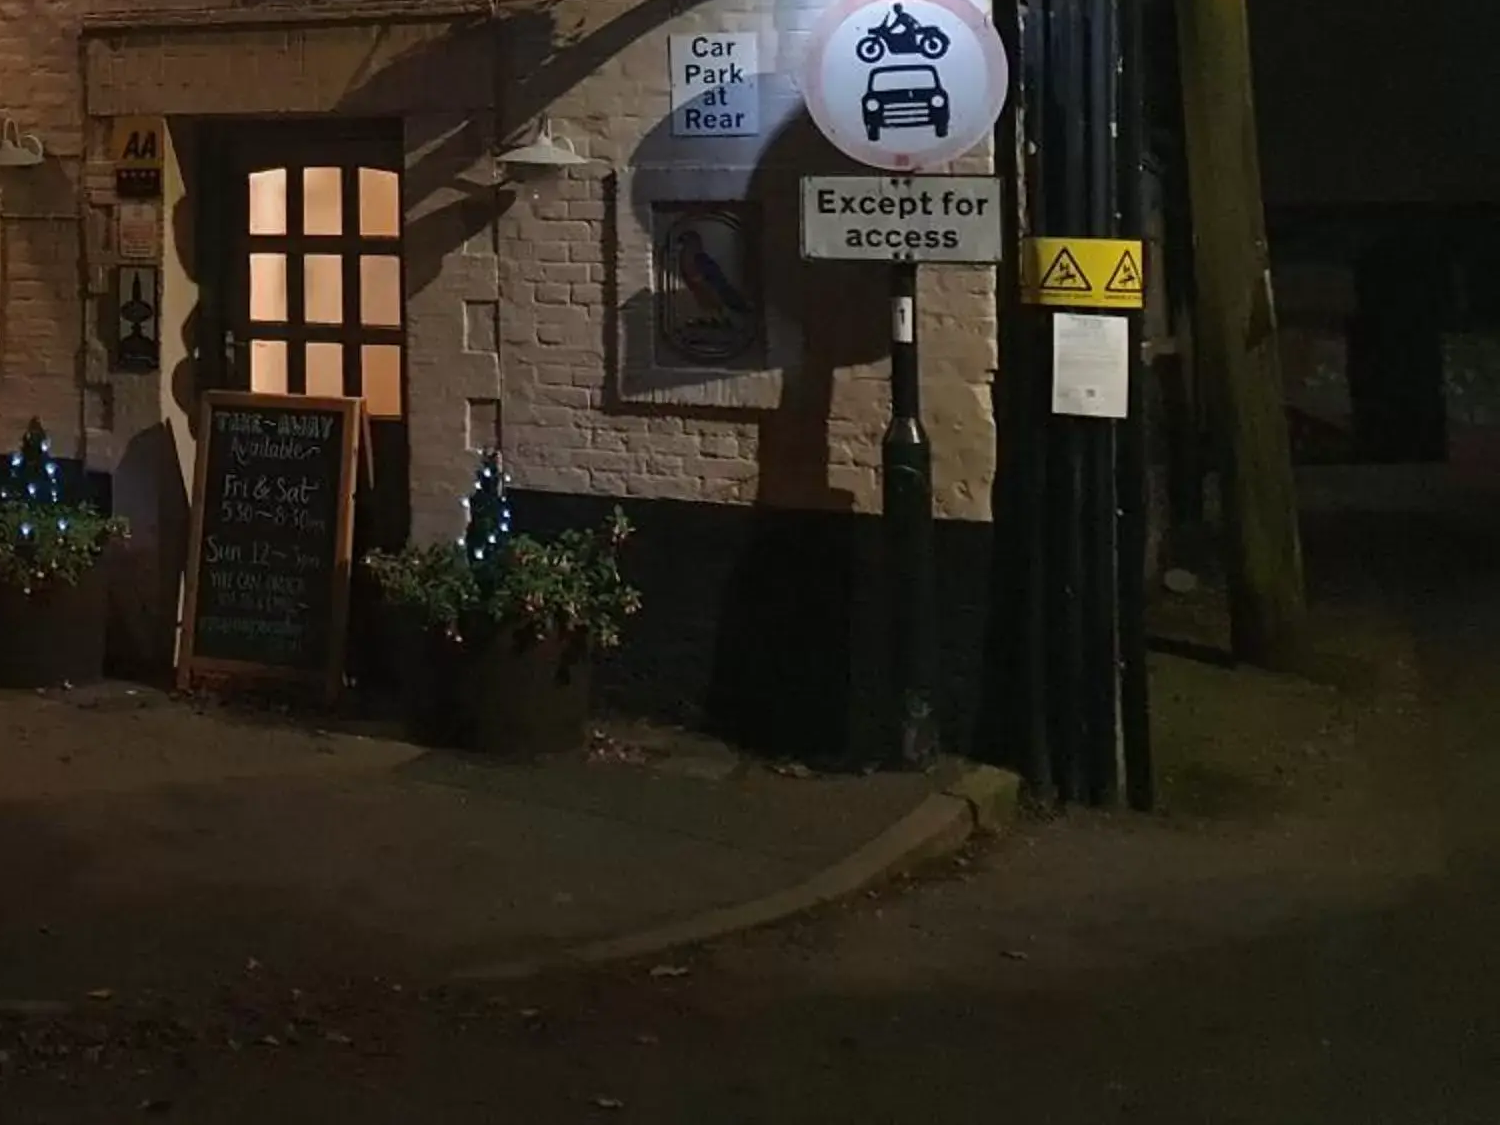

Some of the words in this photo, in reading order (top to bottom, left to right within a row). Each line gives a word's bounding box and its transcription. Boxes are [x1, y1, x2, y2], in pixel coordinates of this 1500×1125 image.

[691, 36, 735, 58] Car
[685, 62, 744, 85] Park
[703, 86, 727, 107] at
[685, 108, 746, 130] Rear
[122, 130, 156, 159] AA
[817, 189, 933, 220] Except
[942, 191, 989, 216] for
[846, 228, 959, 249] access
[223, 473, 249, 498] Fri
[252, 474, 271, 501] &
[276, 476, 319, 505] Sat
[205, 533, 241, 564] Sun
